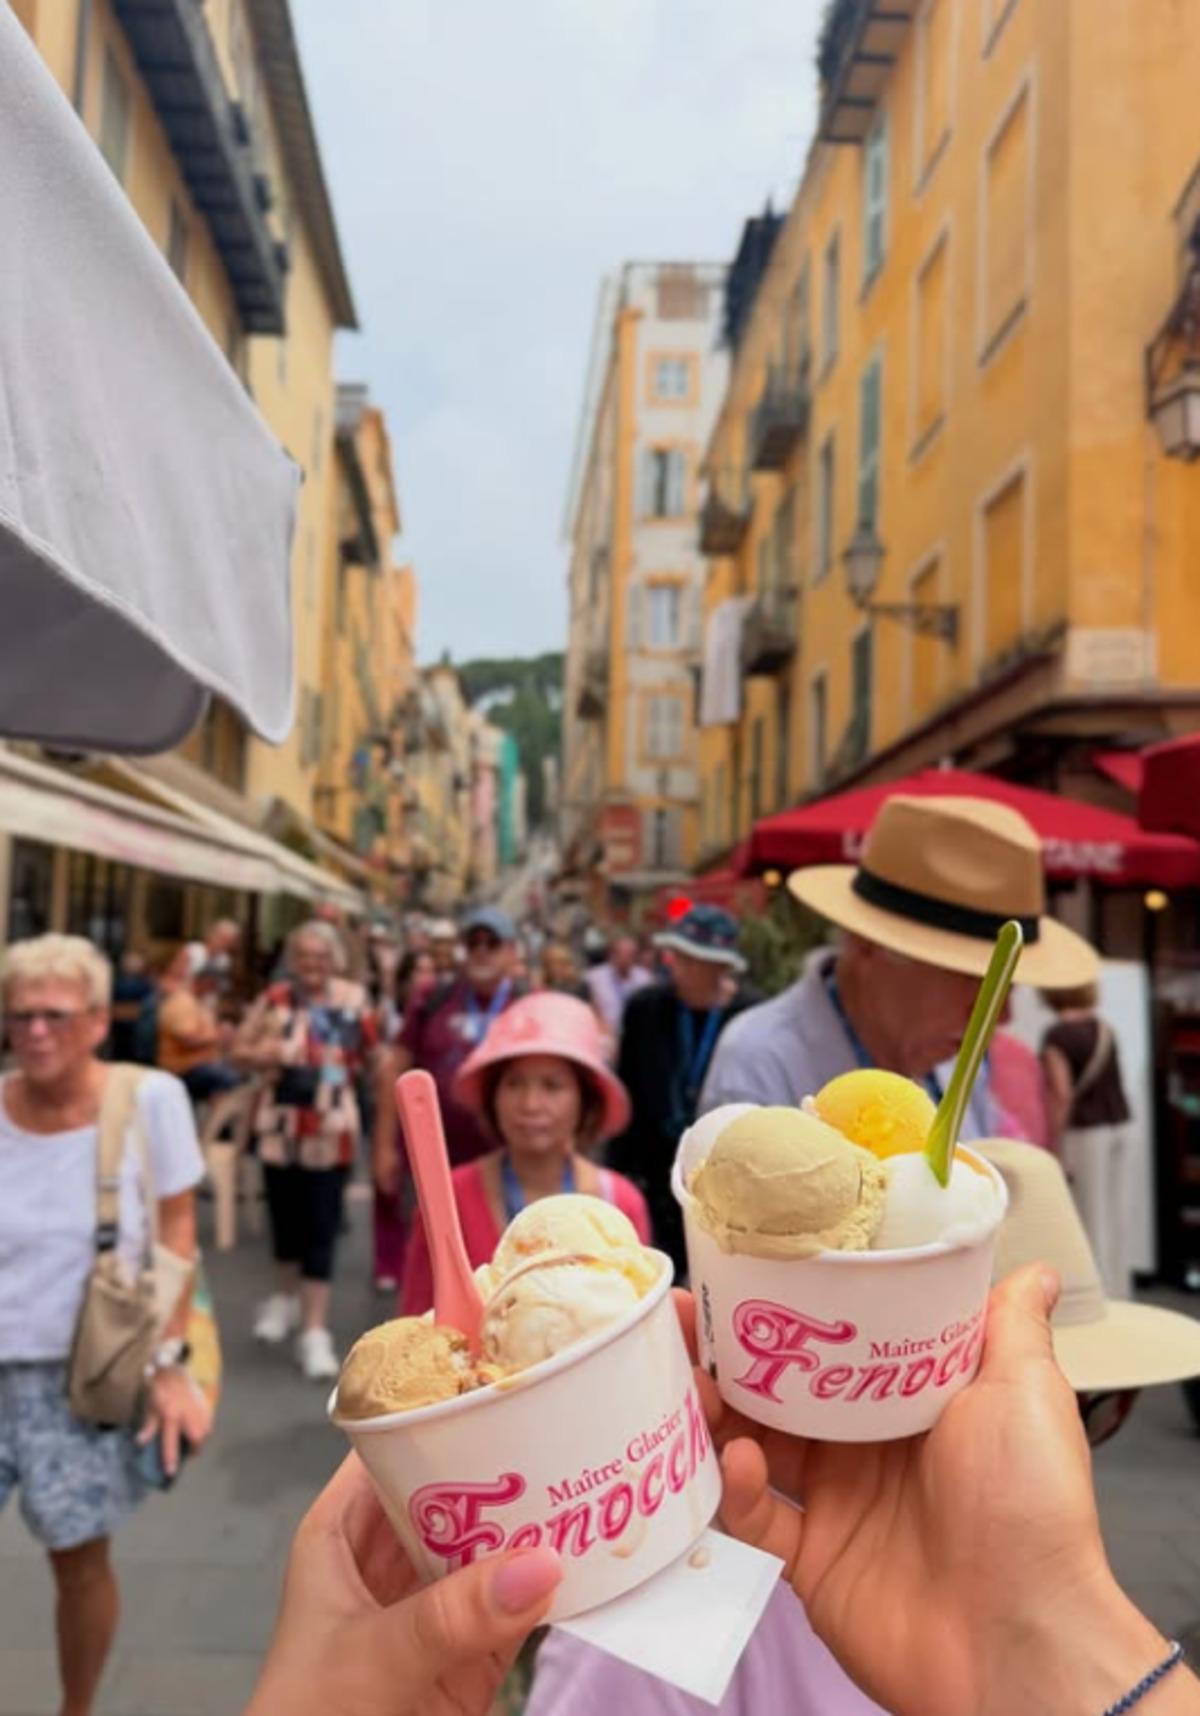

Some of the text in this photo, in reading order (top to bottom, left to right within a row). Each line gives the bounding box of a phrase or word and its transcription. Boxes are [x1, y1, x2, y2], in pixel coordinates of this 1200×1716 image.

[1041, 837, 1124, 872] TAINE
[732, 1299, 983, 1403] Fenocc
[869, 1337, 936, 1359] Maître
[546, 1409, 682, 1507] Maître Glacier
